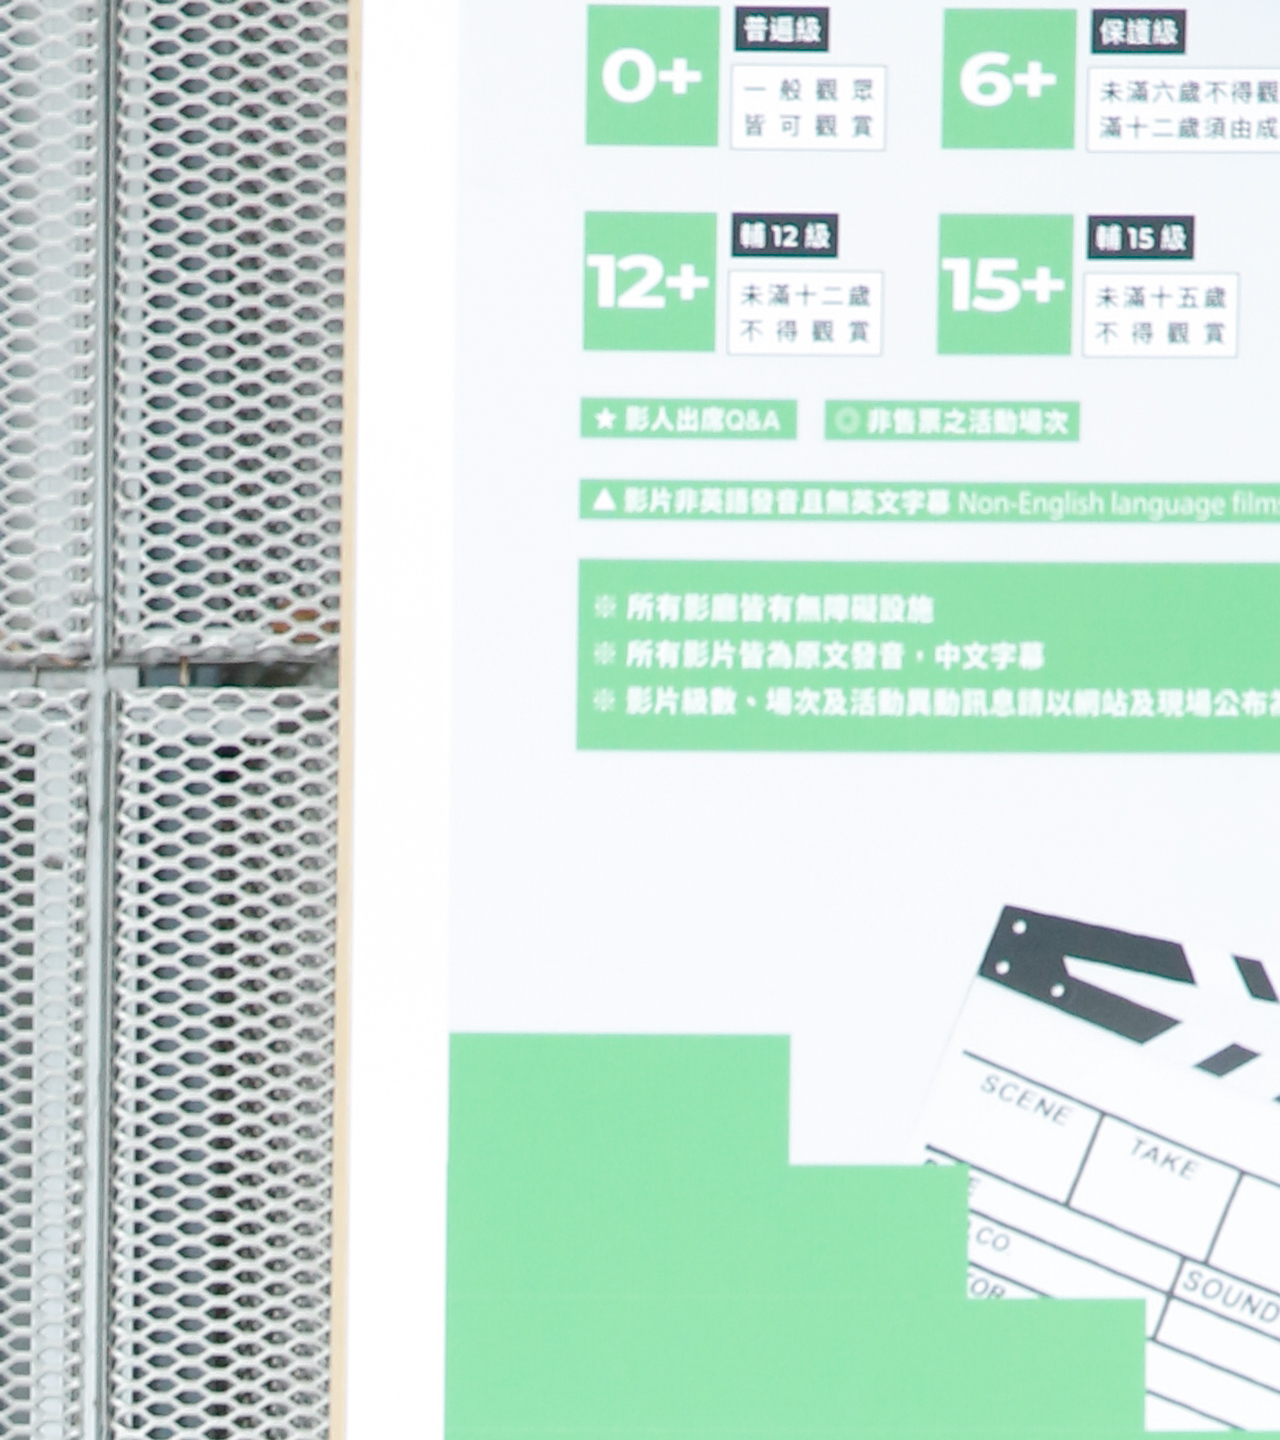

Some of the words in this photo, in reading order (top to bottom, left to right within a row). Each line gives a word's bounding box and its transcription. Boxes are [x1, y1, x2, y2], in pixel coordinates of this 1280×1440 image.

[743, 14, 822, 43] 普遍級
[1099, 17, 1179, 46] 保護級
[602, 47, 702, 104] 0+
[743, 77, 874, 102] 一般觀眾
[959, 50, 1058, 108] 6+
[744, 113, 874, 138] 皆可觀賞
[586, 253, 710, 310] 12+
[740, 283, 872, 309] 未滿十二歲
[942, 256, 1066, 313] 15+
[1095, 285, 1228, 311] 未滿十五歲
[740, 319, 871, 345] 不得觀賞
[1094, 321, 1227, 347] 不得觀賞
[958, 490, 1104, 521] Non-English
[1111, 490, 1226, 522] language
[981, 1073, 1073, 1128] SCENE
[1130, 1138, 1200, 1182] TAKE
[1182, 1269, 1280, 1324] SOUND
